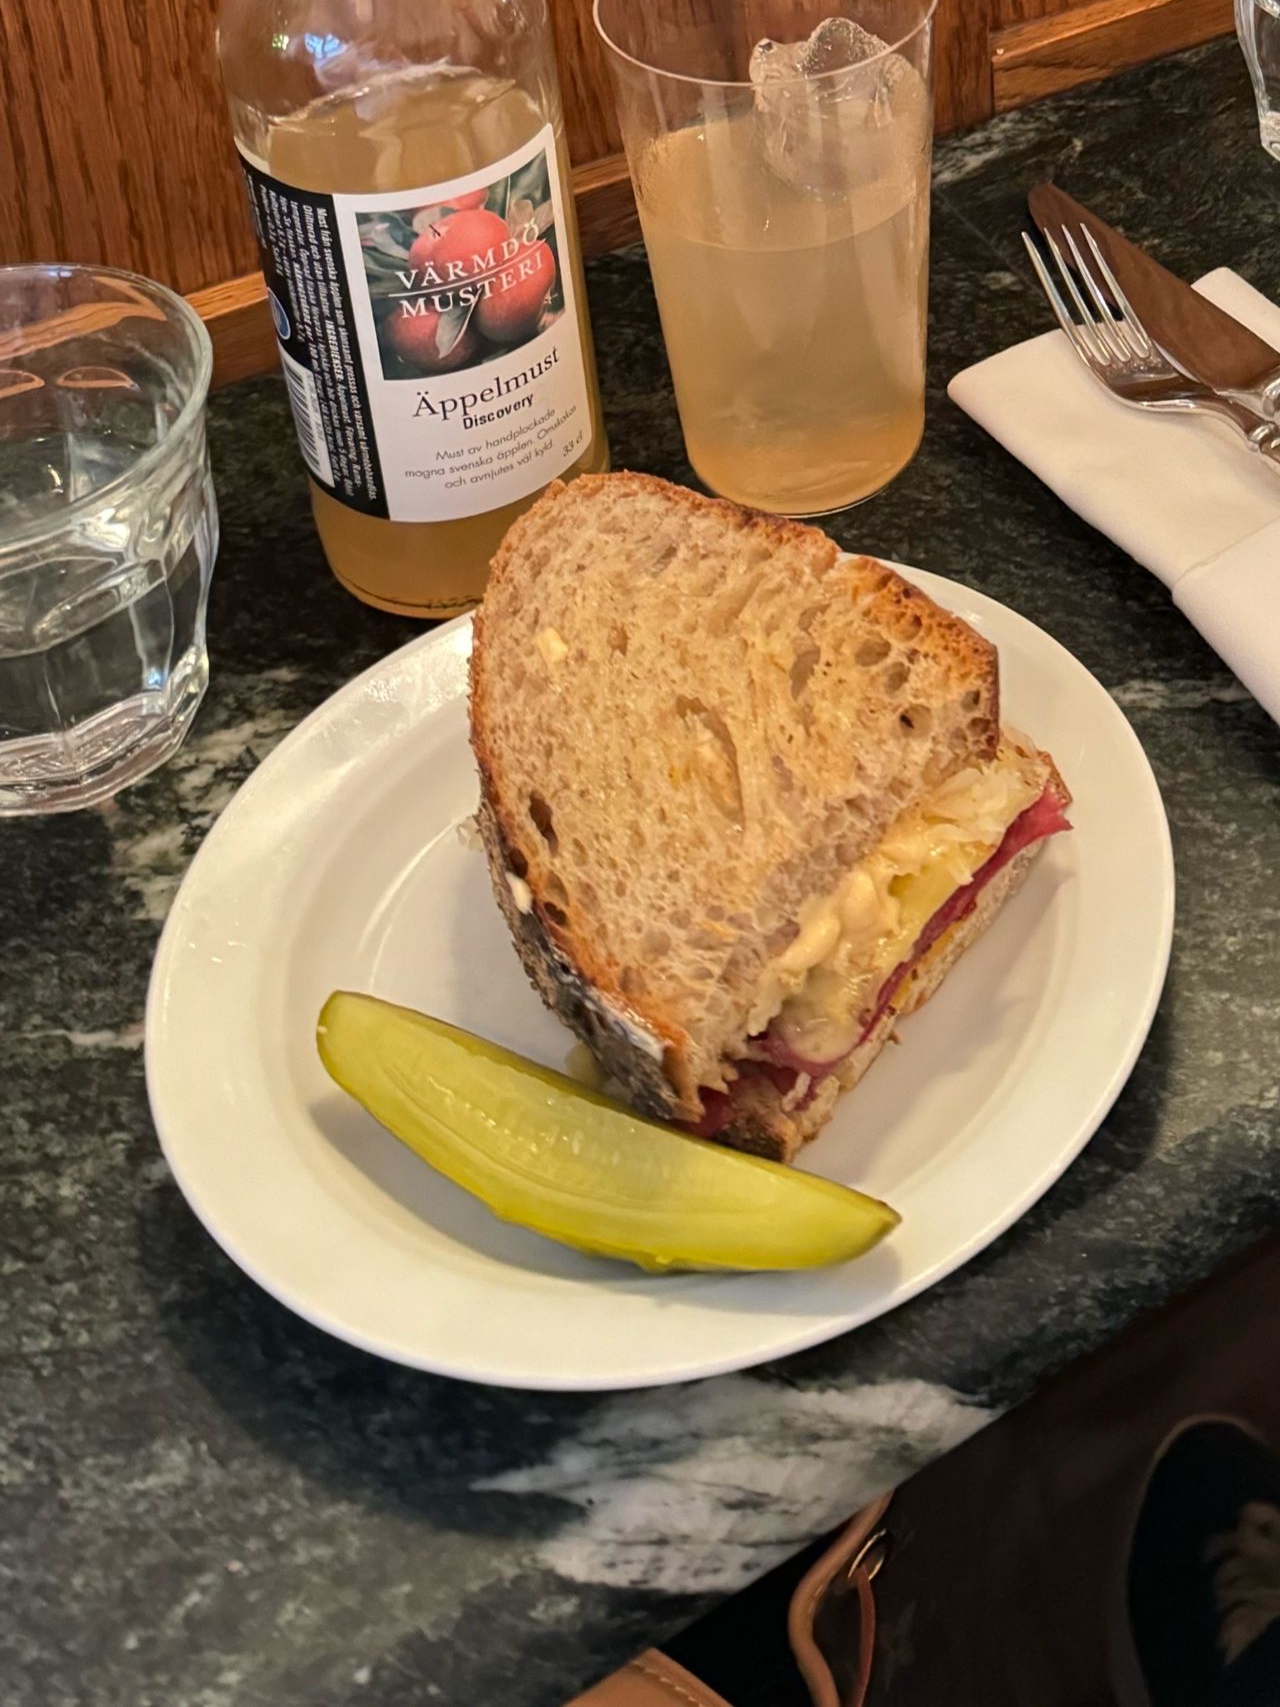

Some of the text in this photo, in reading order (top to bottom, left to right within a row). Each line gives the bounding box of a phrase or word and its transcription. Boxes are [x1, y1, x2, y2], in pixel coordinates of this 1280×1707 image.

[317, 207, 328, 228] Must
[325, 248, 337, 279] svenska
[395, 217, 540, 289] VÄRMDÖ
[400, 250, 543, 318] MUSTERI
[412, 346, 559, 421] Äppelmust
[436, 408, 555, 461] Must av handplockade
[463, 394, 533, 430] Discovery
[405, 469, 445, 479] mogna
[450, 457, 492, 473] svenska
[445, 477, 466, 488] och
[470, 464, 514, 483] avnjutes
[517, 453, 532, 465] väl
[563, 431, 583, 457] 33 cl
